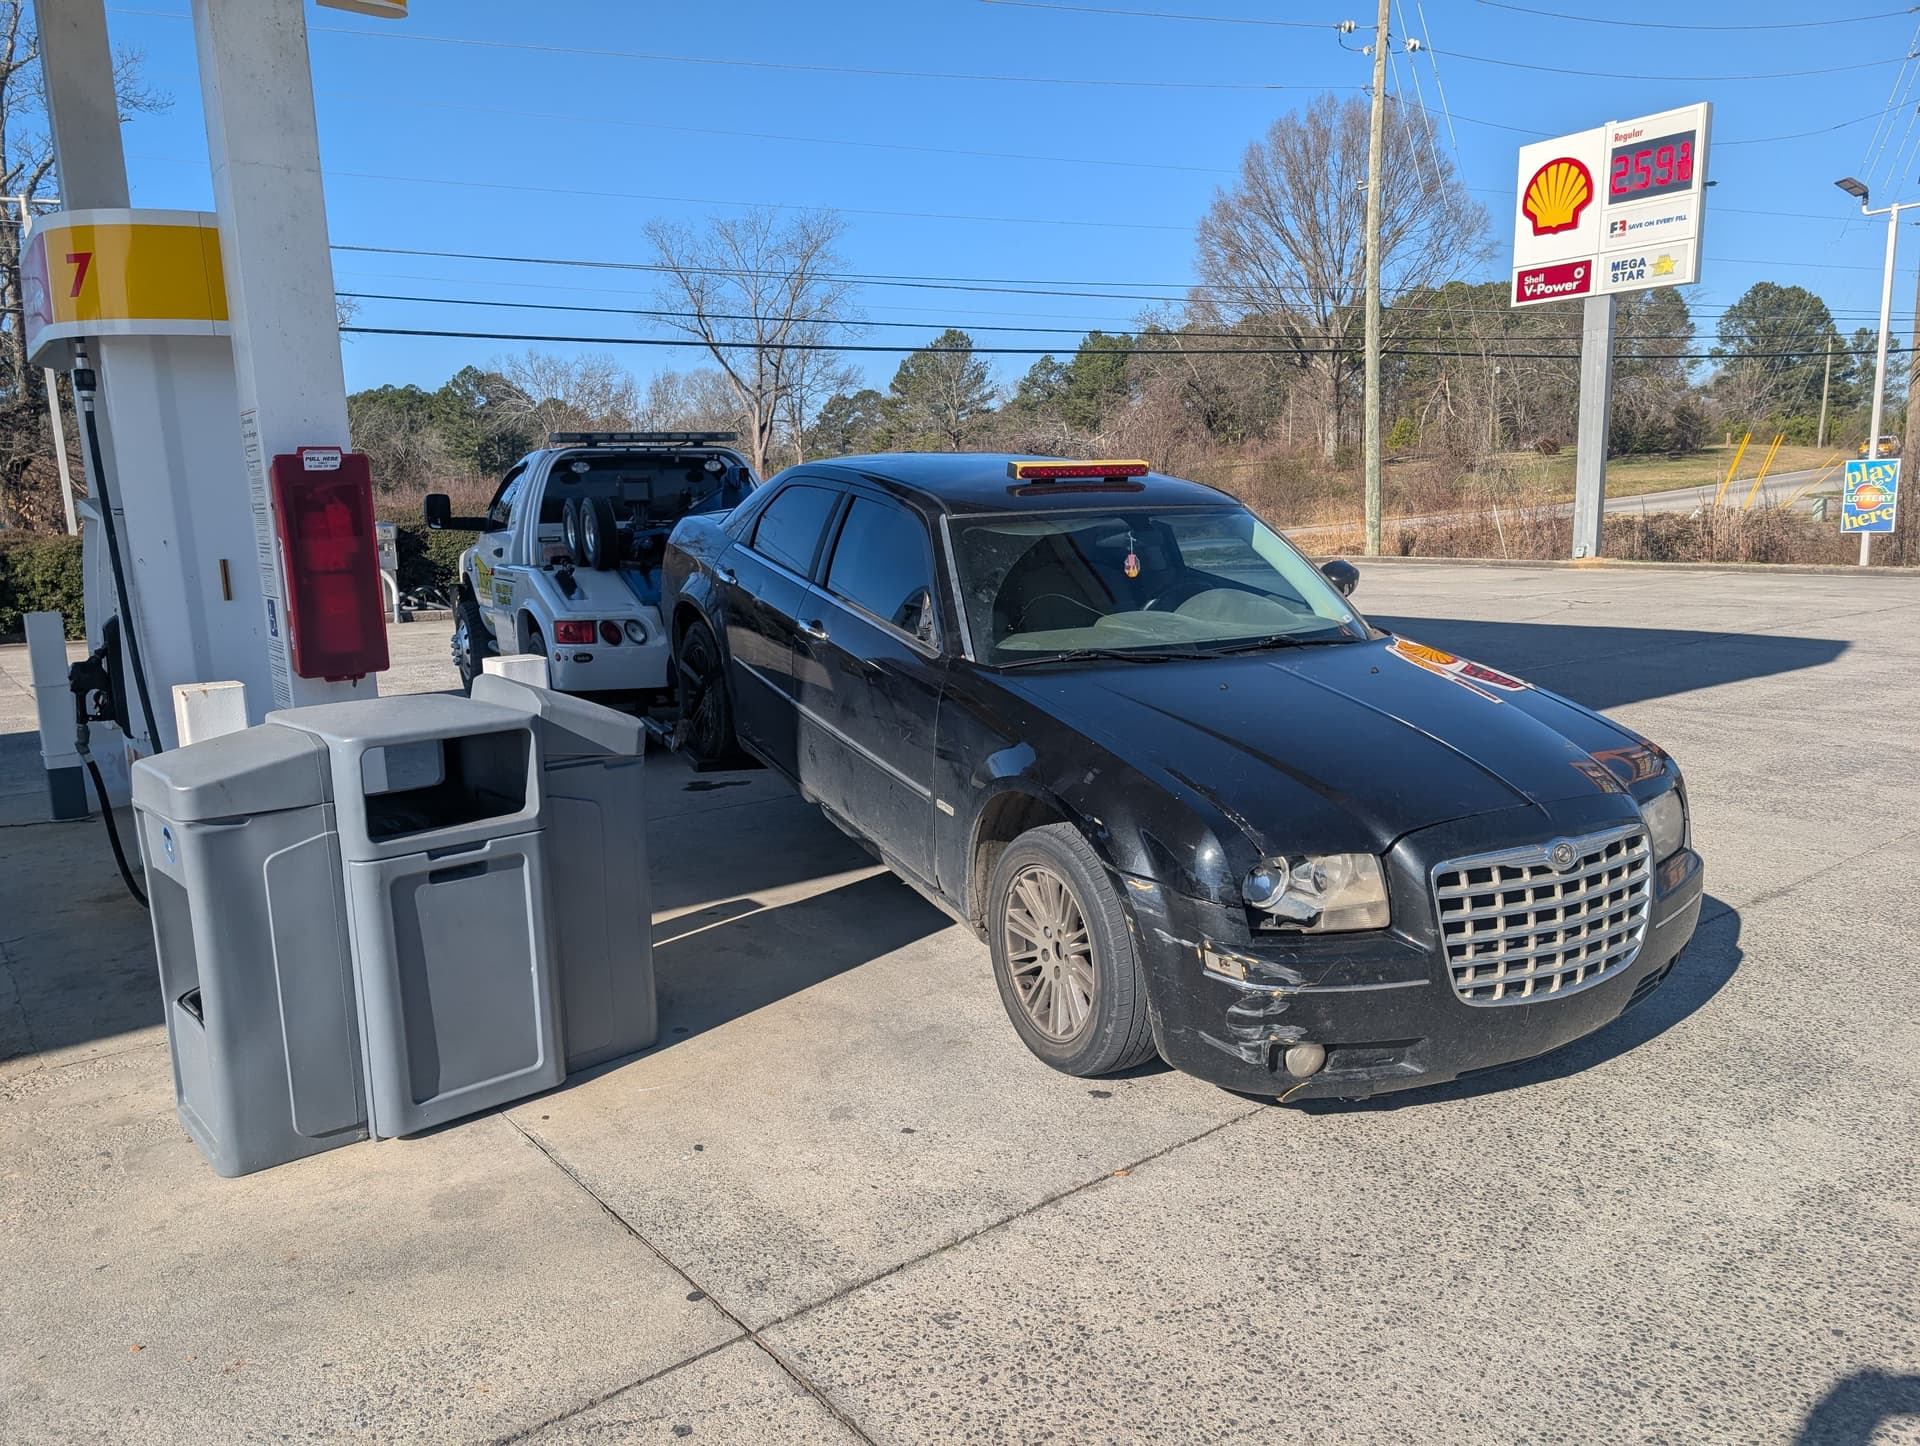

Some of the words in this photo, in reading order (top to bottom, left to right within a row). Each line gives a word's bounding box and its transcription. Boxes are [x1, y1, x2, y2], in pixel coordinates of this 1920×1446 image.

[1614, 128, 1643, 142] Regular
[1628, 222, 1643, 231] SAVE
[1644, 220, 1655, 228] ON
[1655, 216, 1674, 226] EVERY
[1675, 214, 1687, 222] FILL
[1611, 257, 1646, 273] MEGA
[65, 252, 92, 298] 7
[1523, 272, 1545, 285] Shell
[1611, 268, 1645, 283] STAR
[1523, 280, 1580, 297] V-Power
[1847, 463, 1898, 491] play
[1846, 494, 1893, 502] LOTTERY
[1843, 507, 1894, 530] here
